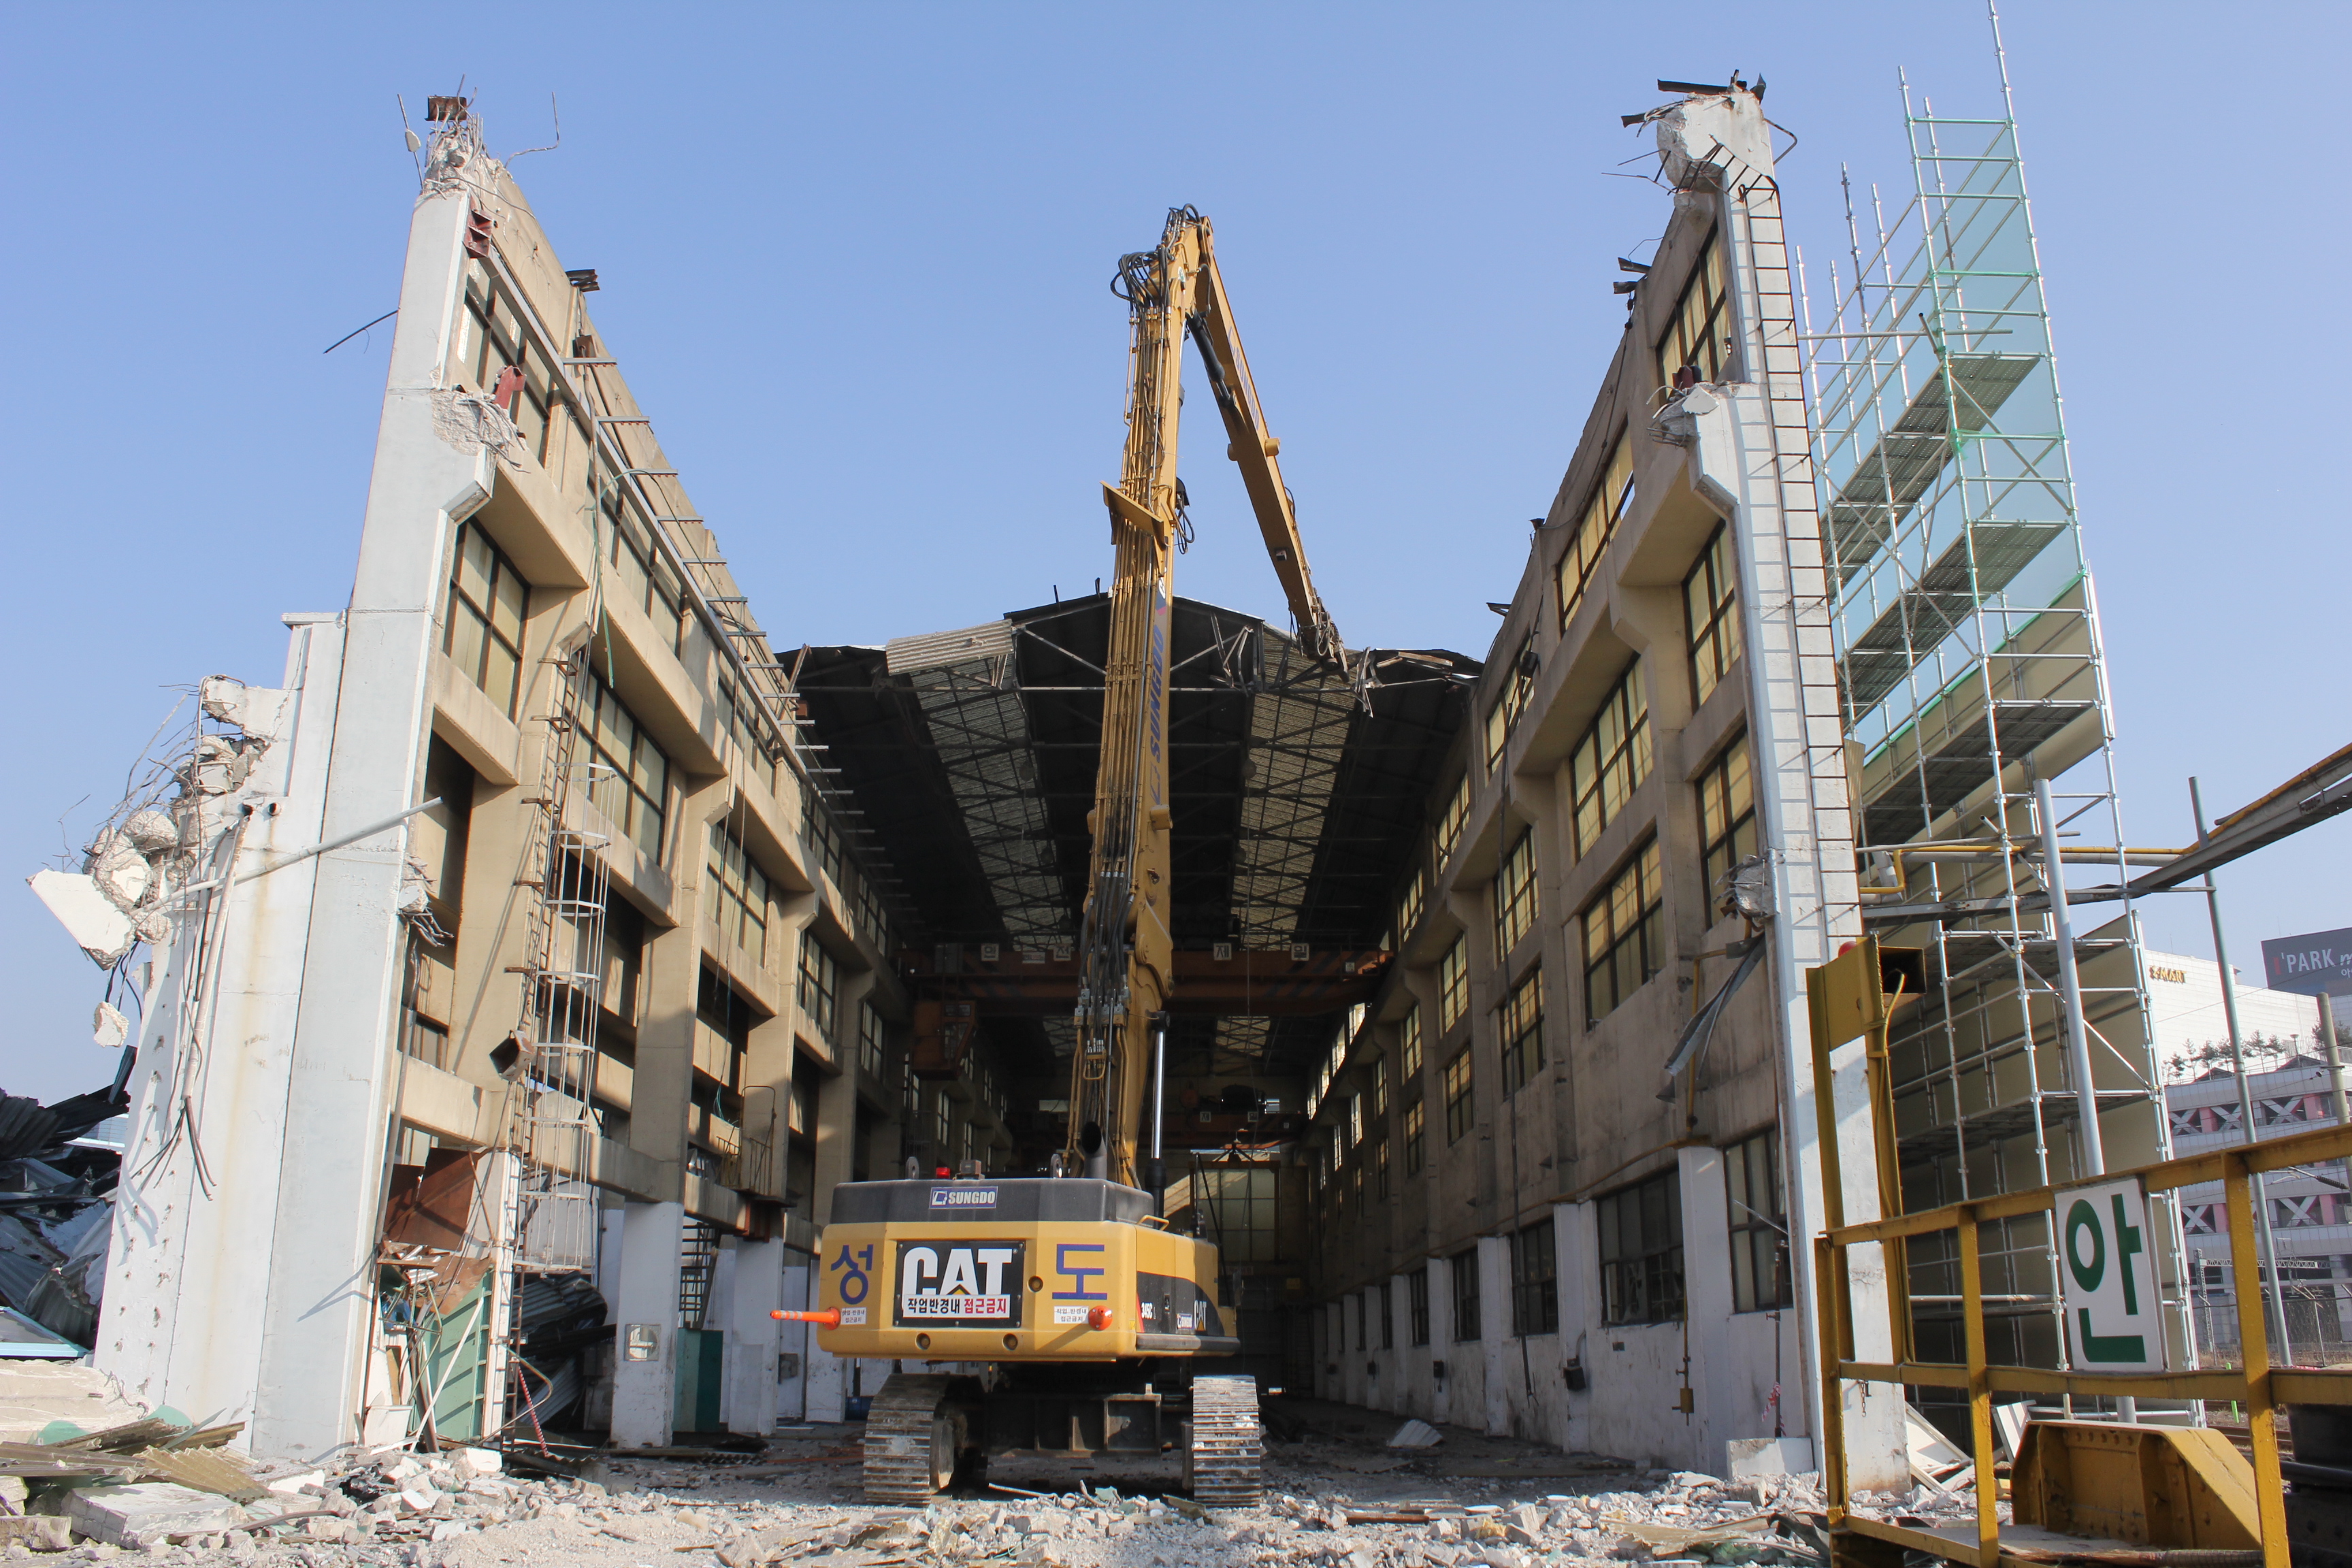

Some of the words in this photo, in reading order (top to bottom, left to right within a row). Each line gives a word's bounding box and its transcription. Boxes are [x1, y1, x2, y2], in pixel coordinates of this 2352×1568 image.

[1235, 346, 1260, 431] SUNGDO
[1150, 624, 1164, 764] SUNGDO
[1215, 945, 1230, 958] 제
[1293, 945, 1307, 959] 일
[948, 1191, 996, 1205] SUNGDO
[830, 1243, 874, 1305] 성
[1051, 1243, 1108, 1300] 도
[901, 1246, 1013, 1297] CAT
[2065, 1194, 2146, 1363] 안
[908, 1298, 960, 1314] 작업반경내
[964, 1298, 1007, 1314] 접근금지
[1141, 1302, 1153, 1319] 345C
[1194, 1300, 1207, 1330] CAT
